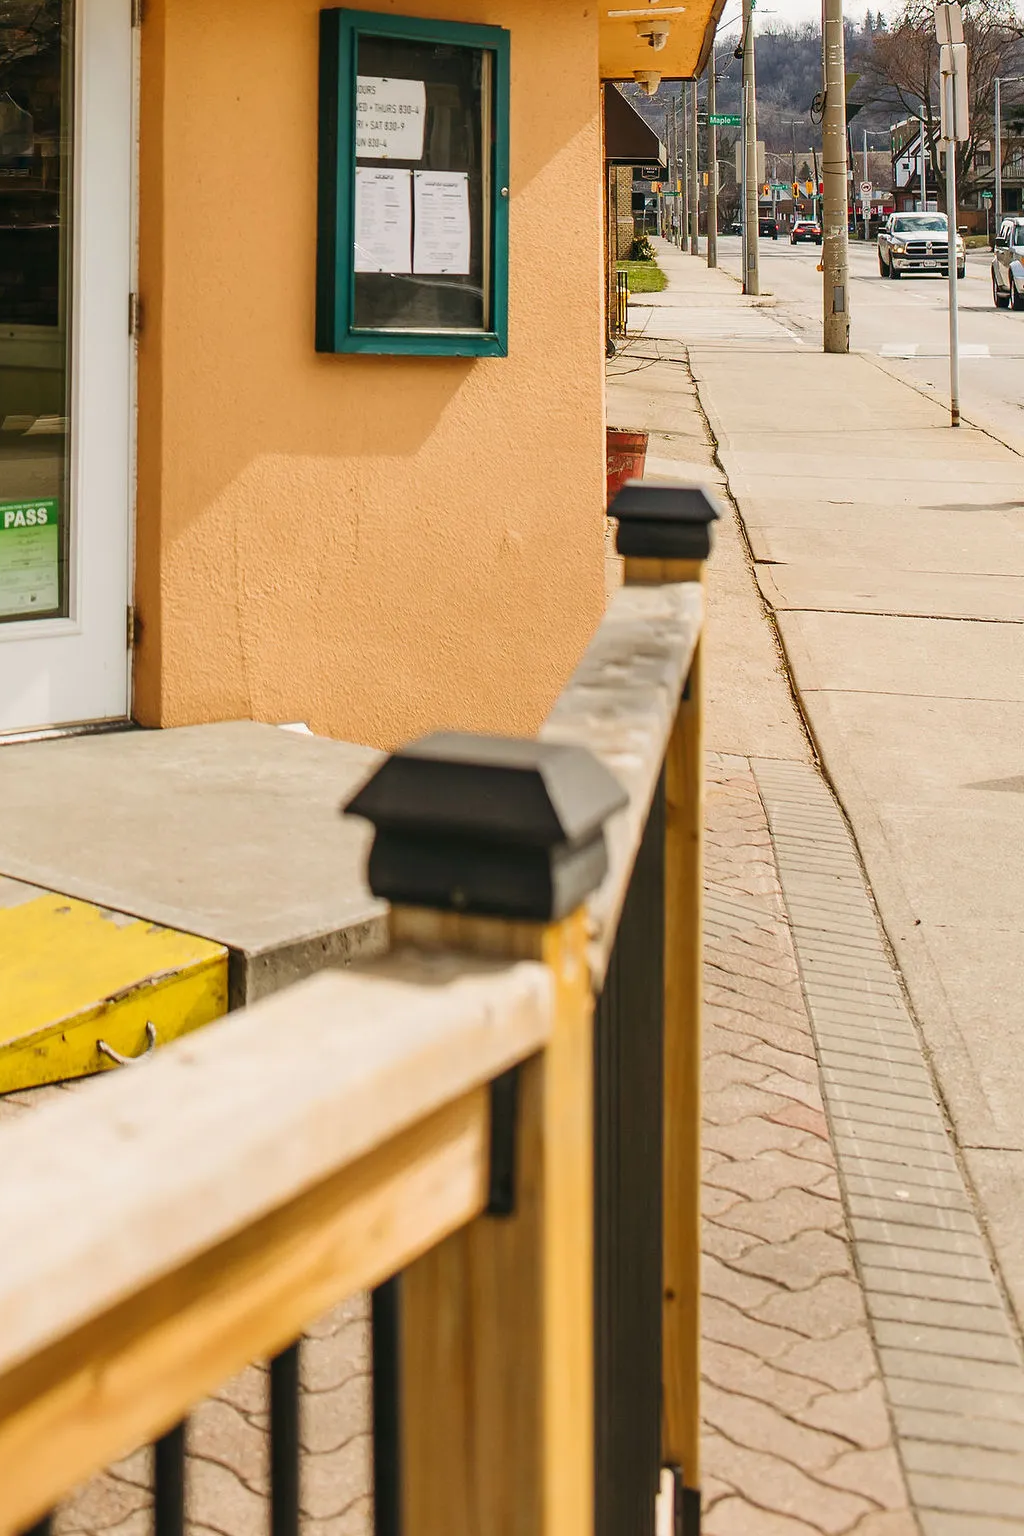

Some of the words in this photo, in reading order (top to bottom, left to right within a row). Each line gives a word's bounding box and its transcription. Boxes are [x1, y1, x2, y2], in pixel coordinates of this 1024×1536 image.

[356, 84, 376, 95] OURS
[356, 102, 368, 113] ED
[709, 116, 731, 126] Maple
[4, 507, 48, 529] PASS
